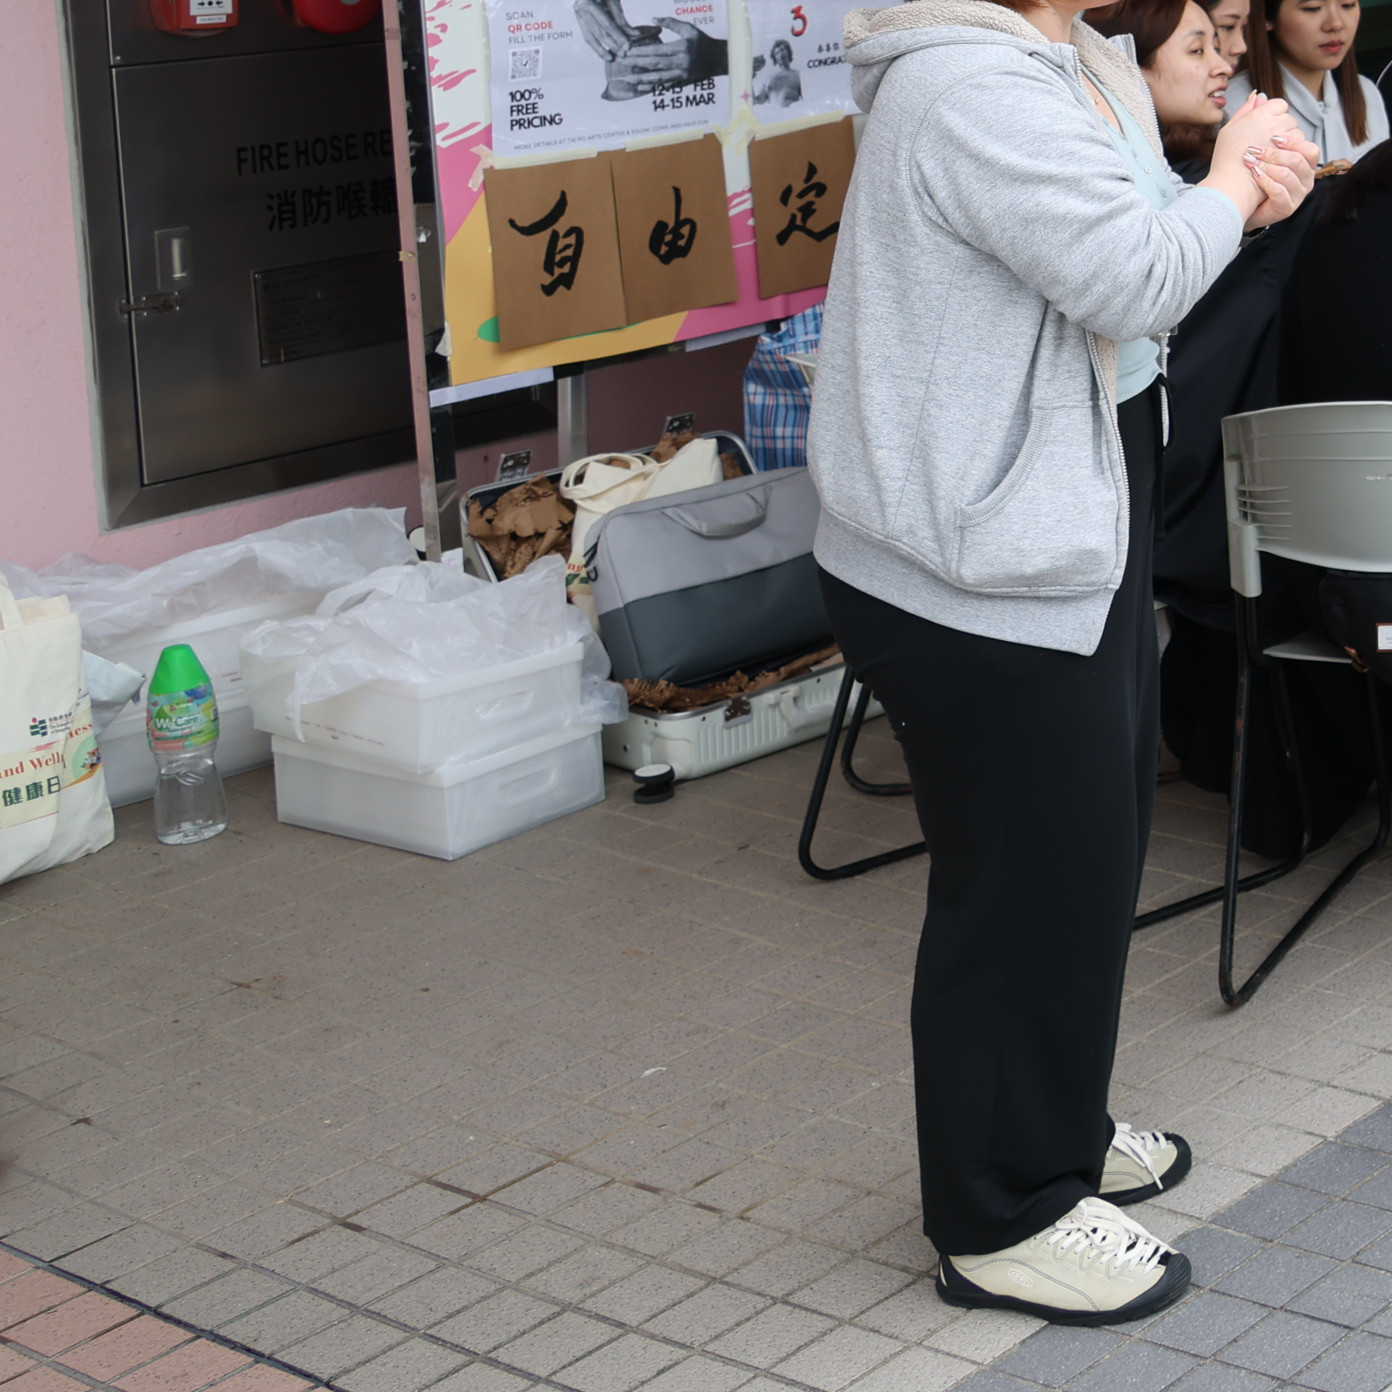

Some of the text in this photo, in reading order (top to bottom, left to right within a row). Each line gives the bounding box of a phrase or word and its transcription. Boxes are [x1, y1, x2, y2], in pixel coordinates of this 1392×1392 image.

[506, 10, 534, 21] SCAN
[675, 4, 713, 16] CHANCE
[508, 21, 553, 34] QR CODE
[693, 16, 714, 26] EVER
[790, 5, 808, 37] 3
[509, 31, 574, 45] FILL THE FORM
[807, 56, 846, 69] CONGRA
[693, 78, 715, 92] FEB
[509, 88, 544, 103] 100%
[652, 93, 716, 112] 14-15 MAR
[510, 102, 539, 117] FREE
[510, 113, 563, 132] PRICING
[236, 129, 393, 175] FIRE HOSE RE
[2, 775, 61, 807] 健康日
